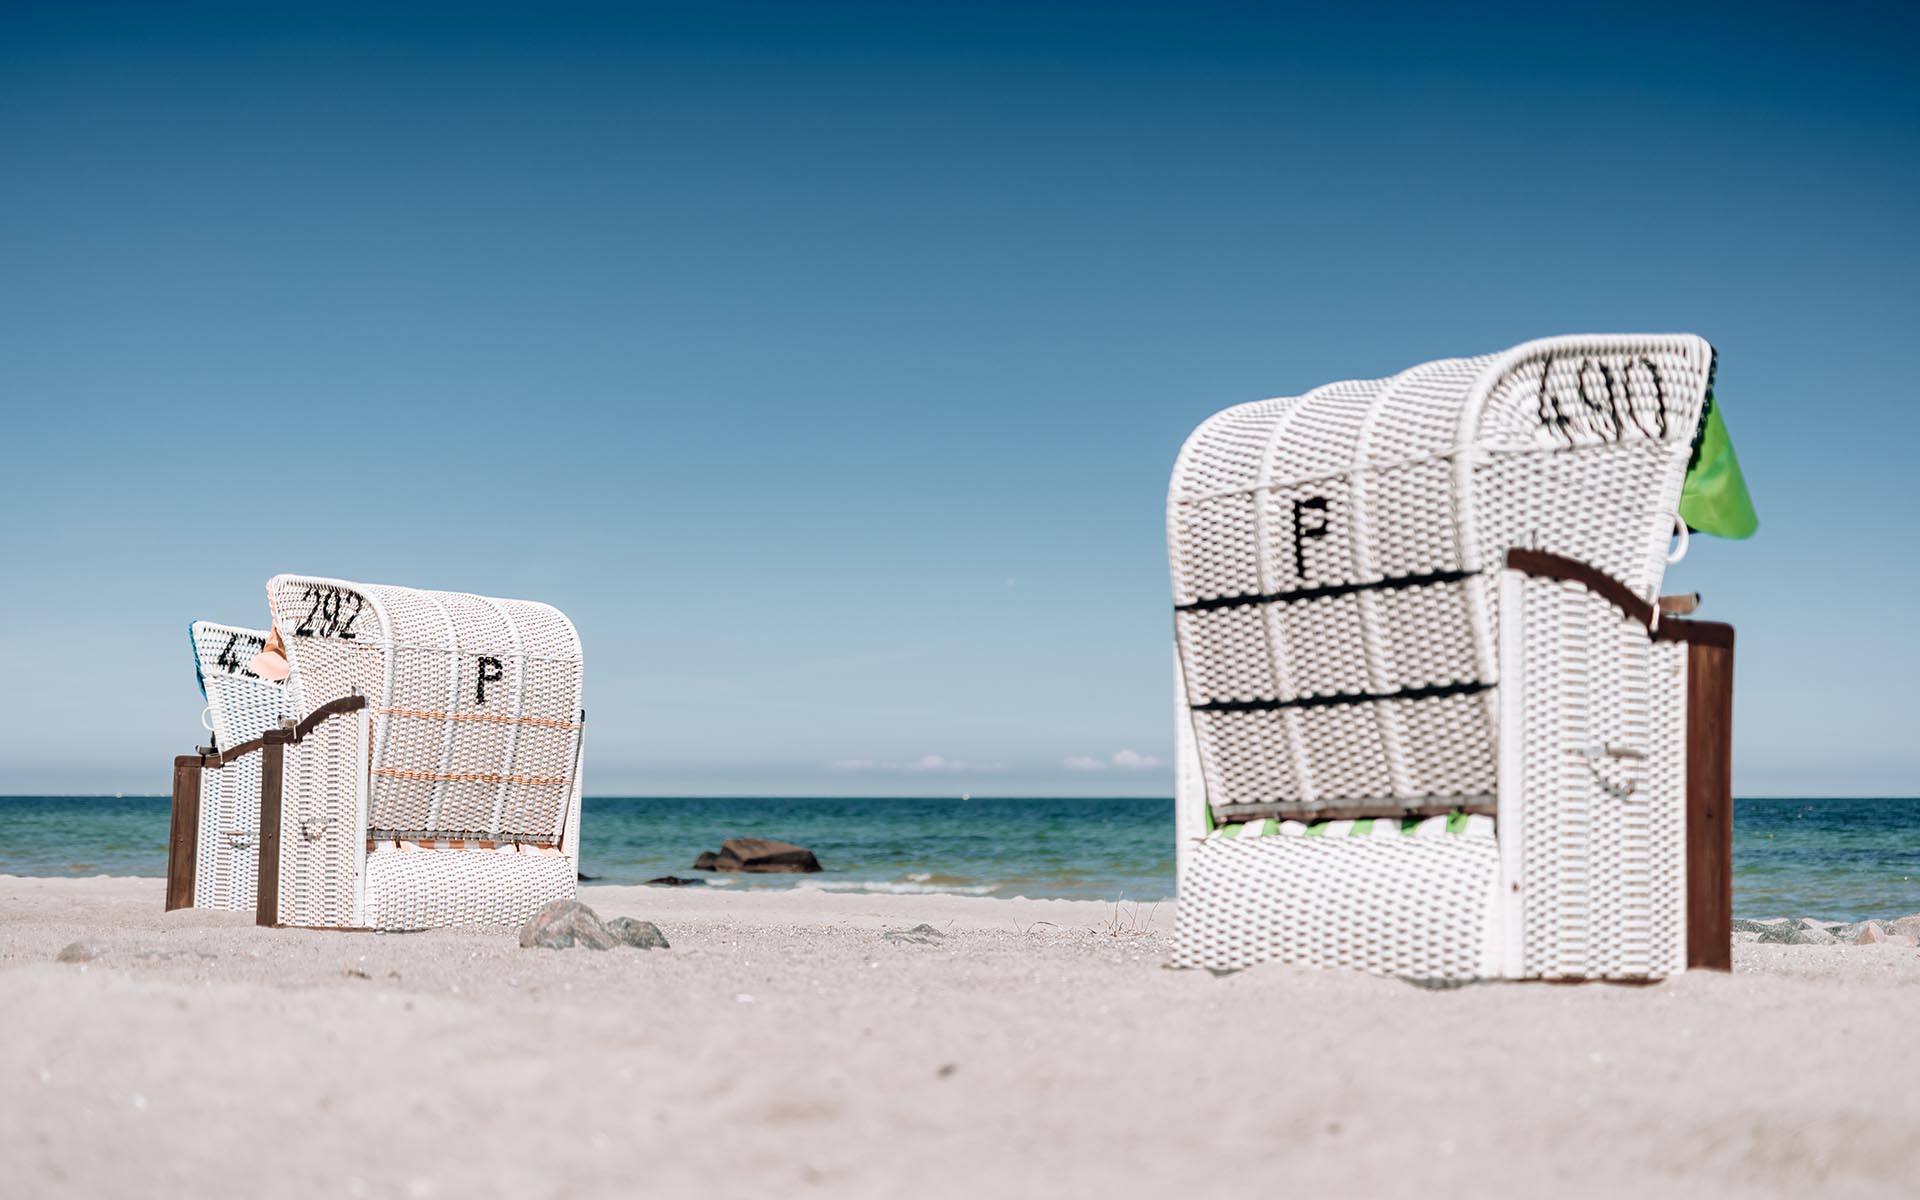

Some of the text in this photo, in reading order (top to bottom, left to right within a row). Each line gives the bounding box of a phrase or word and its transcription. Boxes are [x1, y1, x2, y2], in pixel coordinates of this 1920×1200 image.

[1292, 496, 1328, 579] P
[296, 587, 364, 639] 292
[476, 657, 503, 705] P
